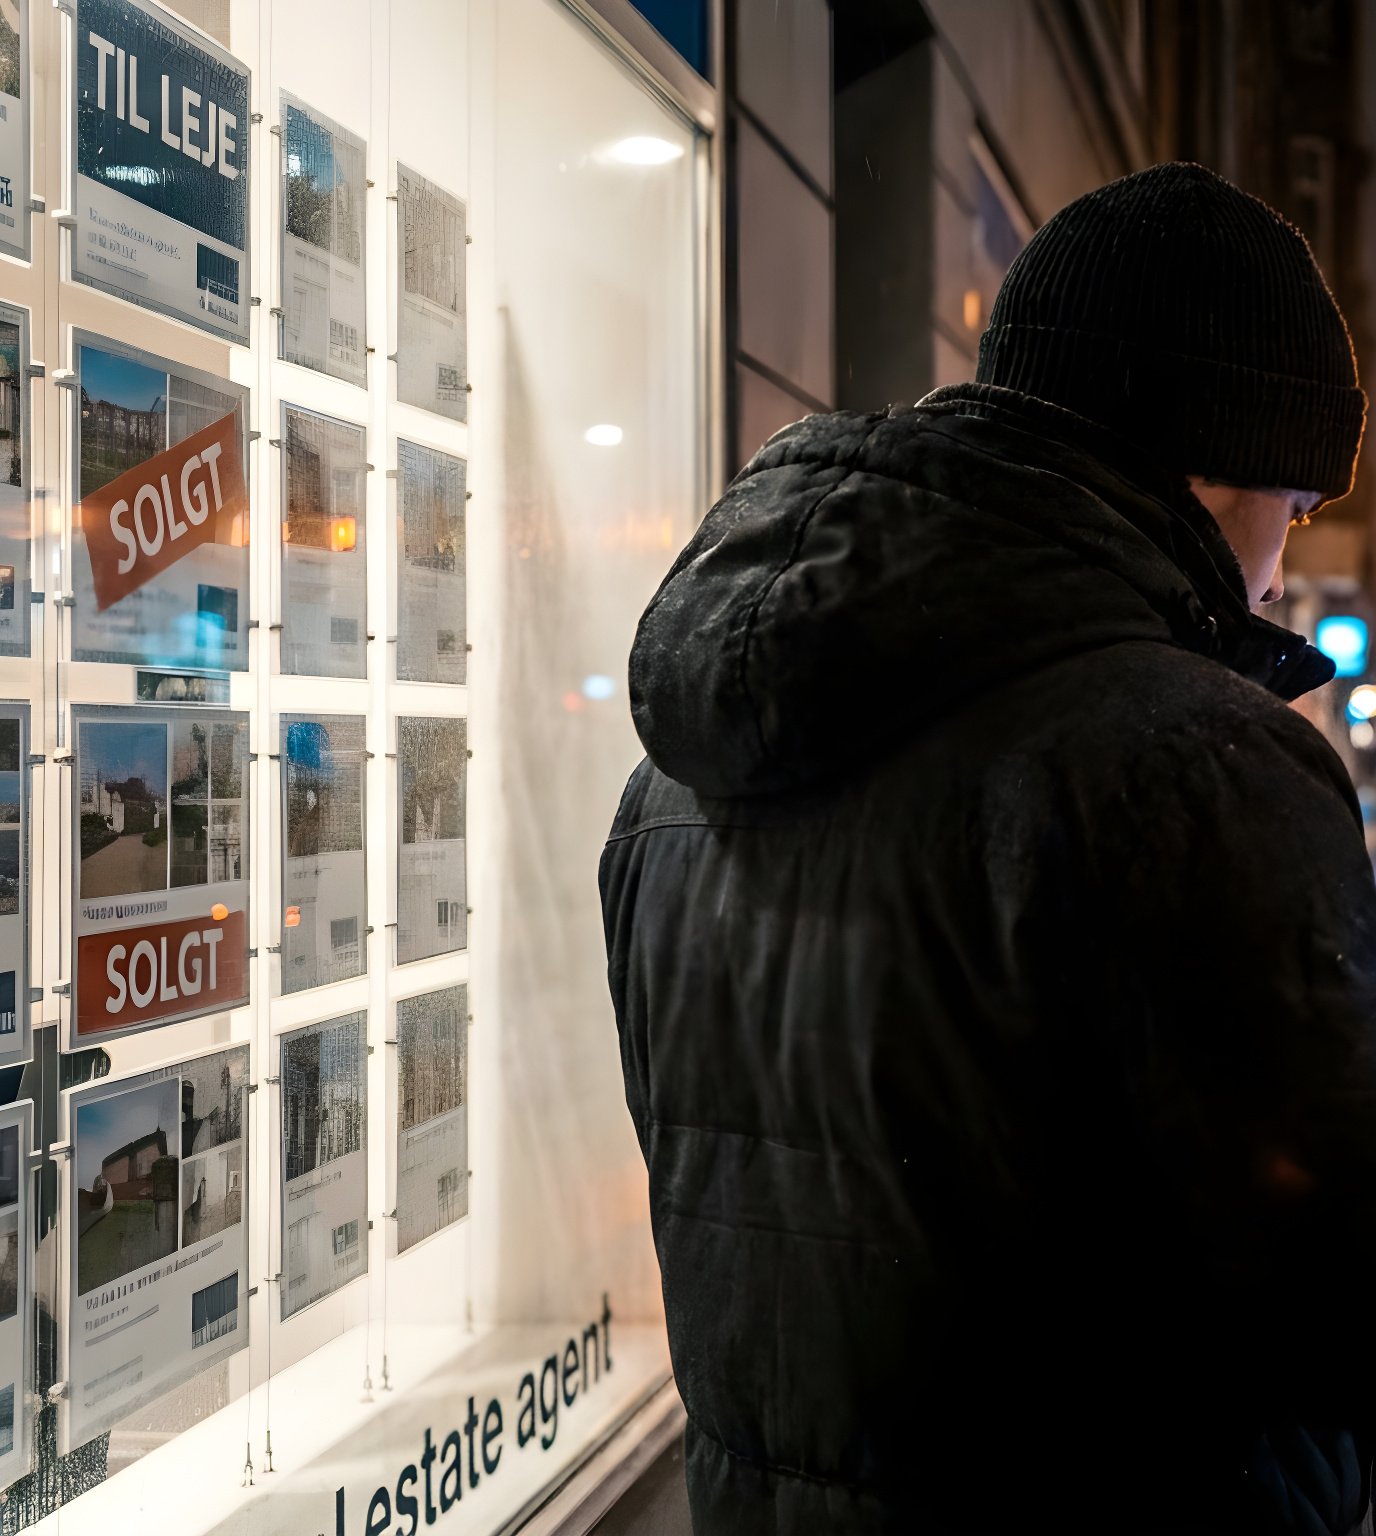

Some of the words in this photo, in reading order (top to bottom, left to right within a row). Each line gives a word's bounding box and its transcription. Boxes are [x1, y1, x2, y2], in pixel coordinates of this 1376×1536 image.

[89, 31, 150, 134] TIL
[161, 74, 239, 181] LEJE
[109, 441, 223, 575] SOLGT
[105, 927, 224, 1014] SOLGT
[365, 1396, 503, 1536] estate
[516, 1292, 612, 1450] agent
